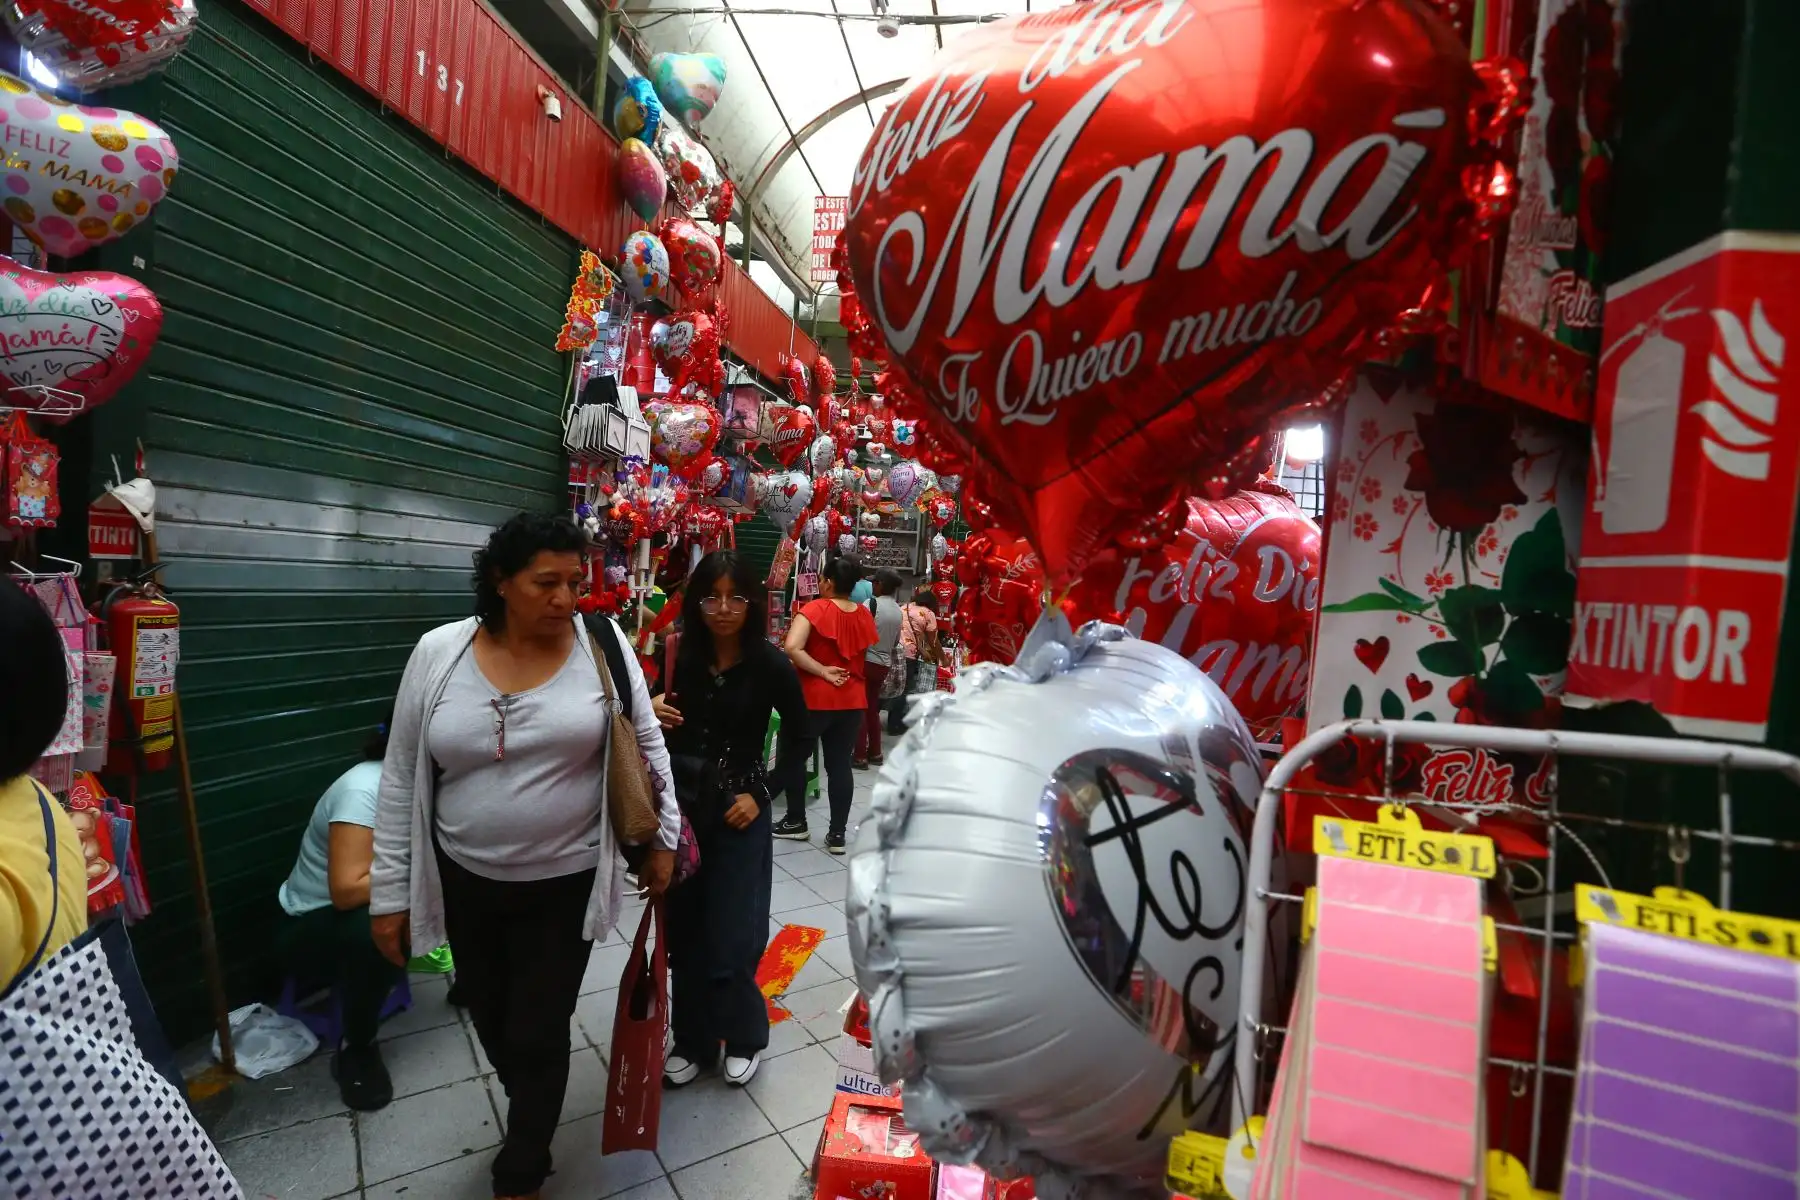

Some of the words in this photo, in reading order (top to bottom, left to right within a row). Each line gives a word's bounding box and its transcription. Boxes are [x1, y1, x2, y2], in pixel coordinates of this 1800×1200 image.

[5, 124, 71, 159] FELIZ
[872, 58, 1447, 356] Mamá
[939, 352, 982, 424] Te
[996, 329, 1143, 426] Quiero
[1157, 270, 1323, 364] mucho
[1114, 536, 1240, 614] Feliz
[1570, 601, 1751, 686] XTINTOR
[1421, 748, 1513, 810] Feliz
